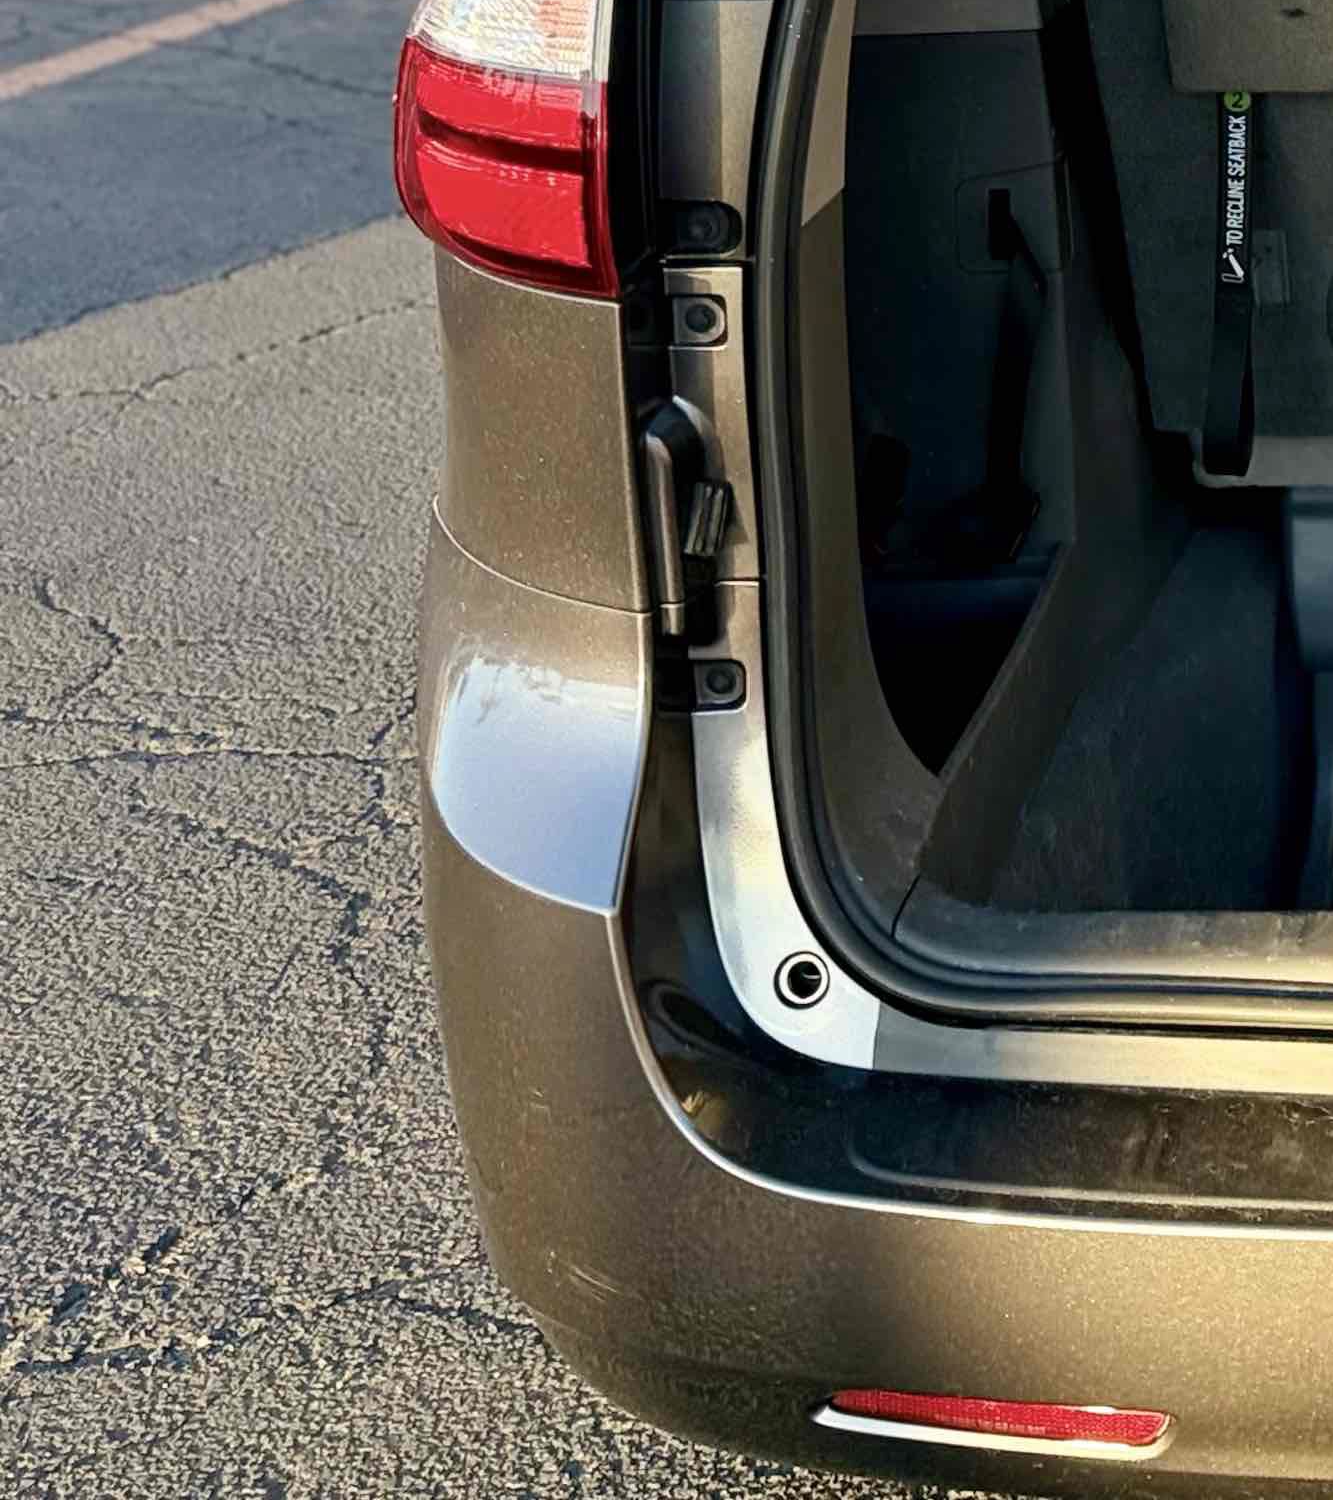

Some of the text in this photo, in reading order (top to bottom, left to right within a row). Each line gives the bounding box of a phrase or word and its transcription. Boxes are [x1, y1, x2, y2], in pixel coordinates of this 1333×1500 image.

[1226, 115, 1247, 246] TO RECLINE SEATBACK
